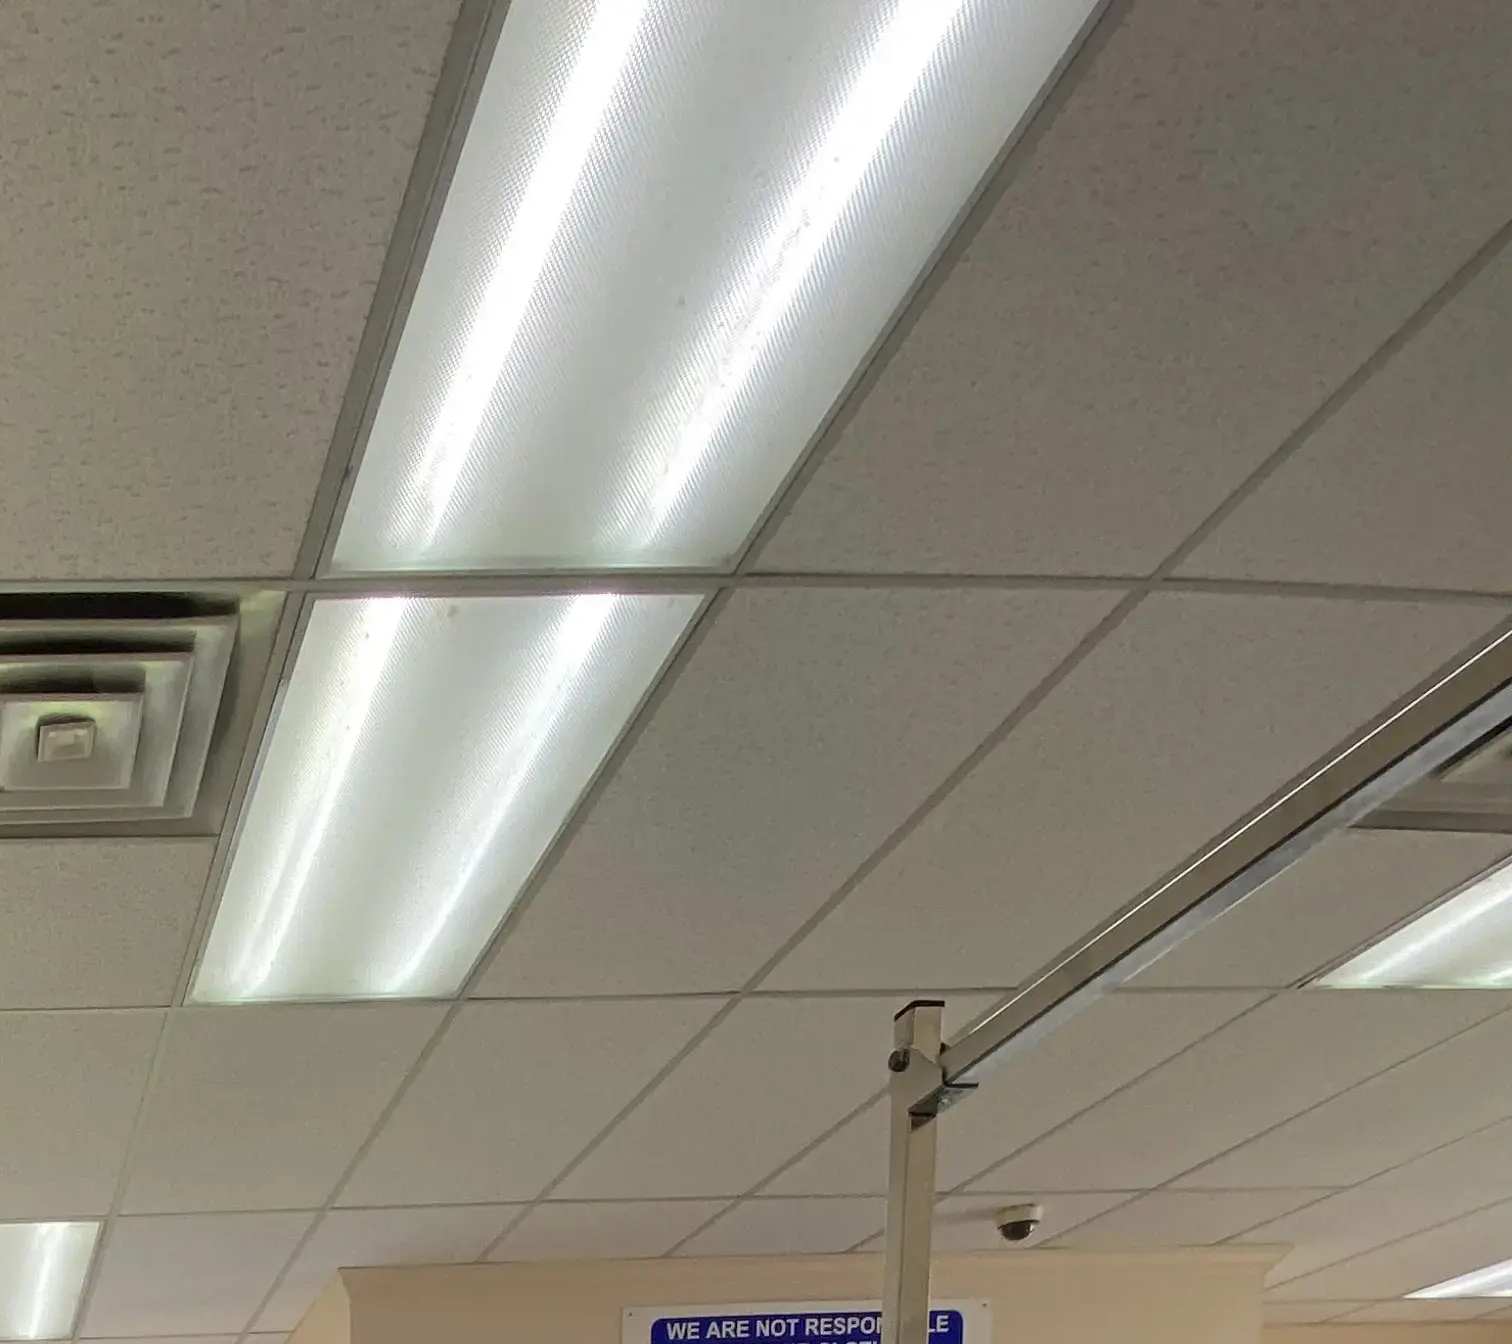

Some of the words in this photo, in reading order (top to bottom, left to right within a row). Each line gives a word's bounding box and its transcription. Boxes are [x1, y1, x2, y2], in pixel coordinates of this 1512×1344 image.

[666, 1322, 700, 1340] WE
[705, 1320, 750, 1339] ARE
[755, 1318, 799, 1337] NOT
